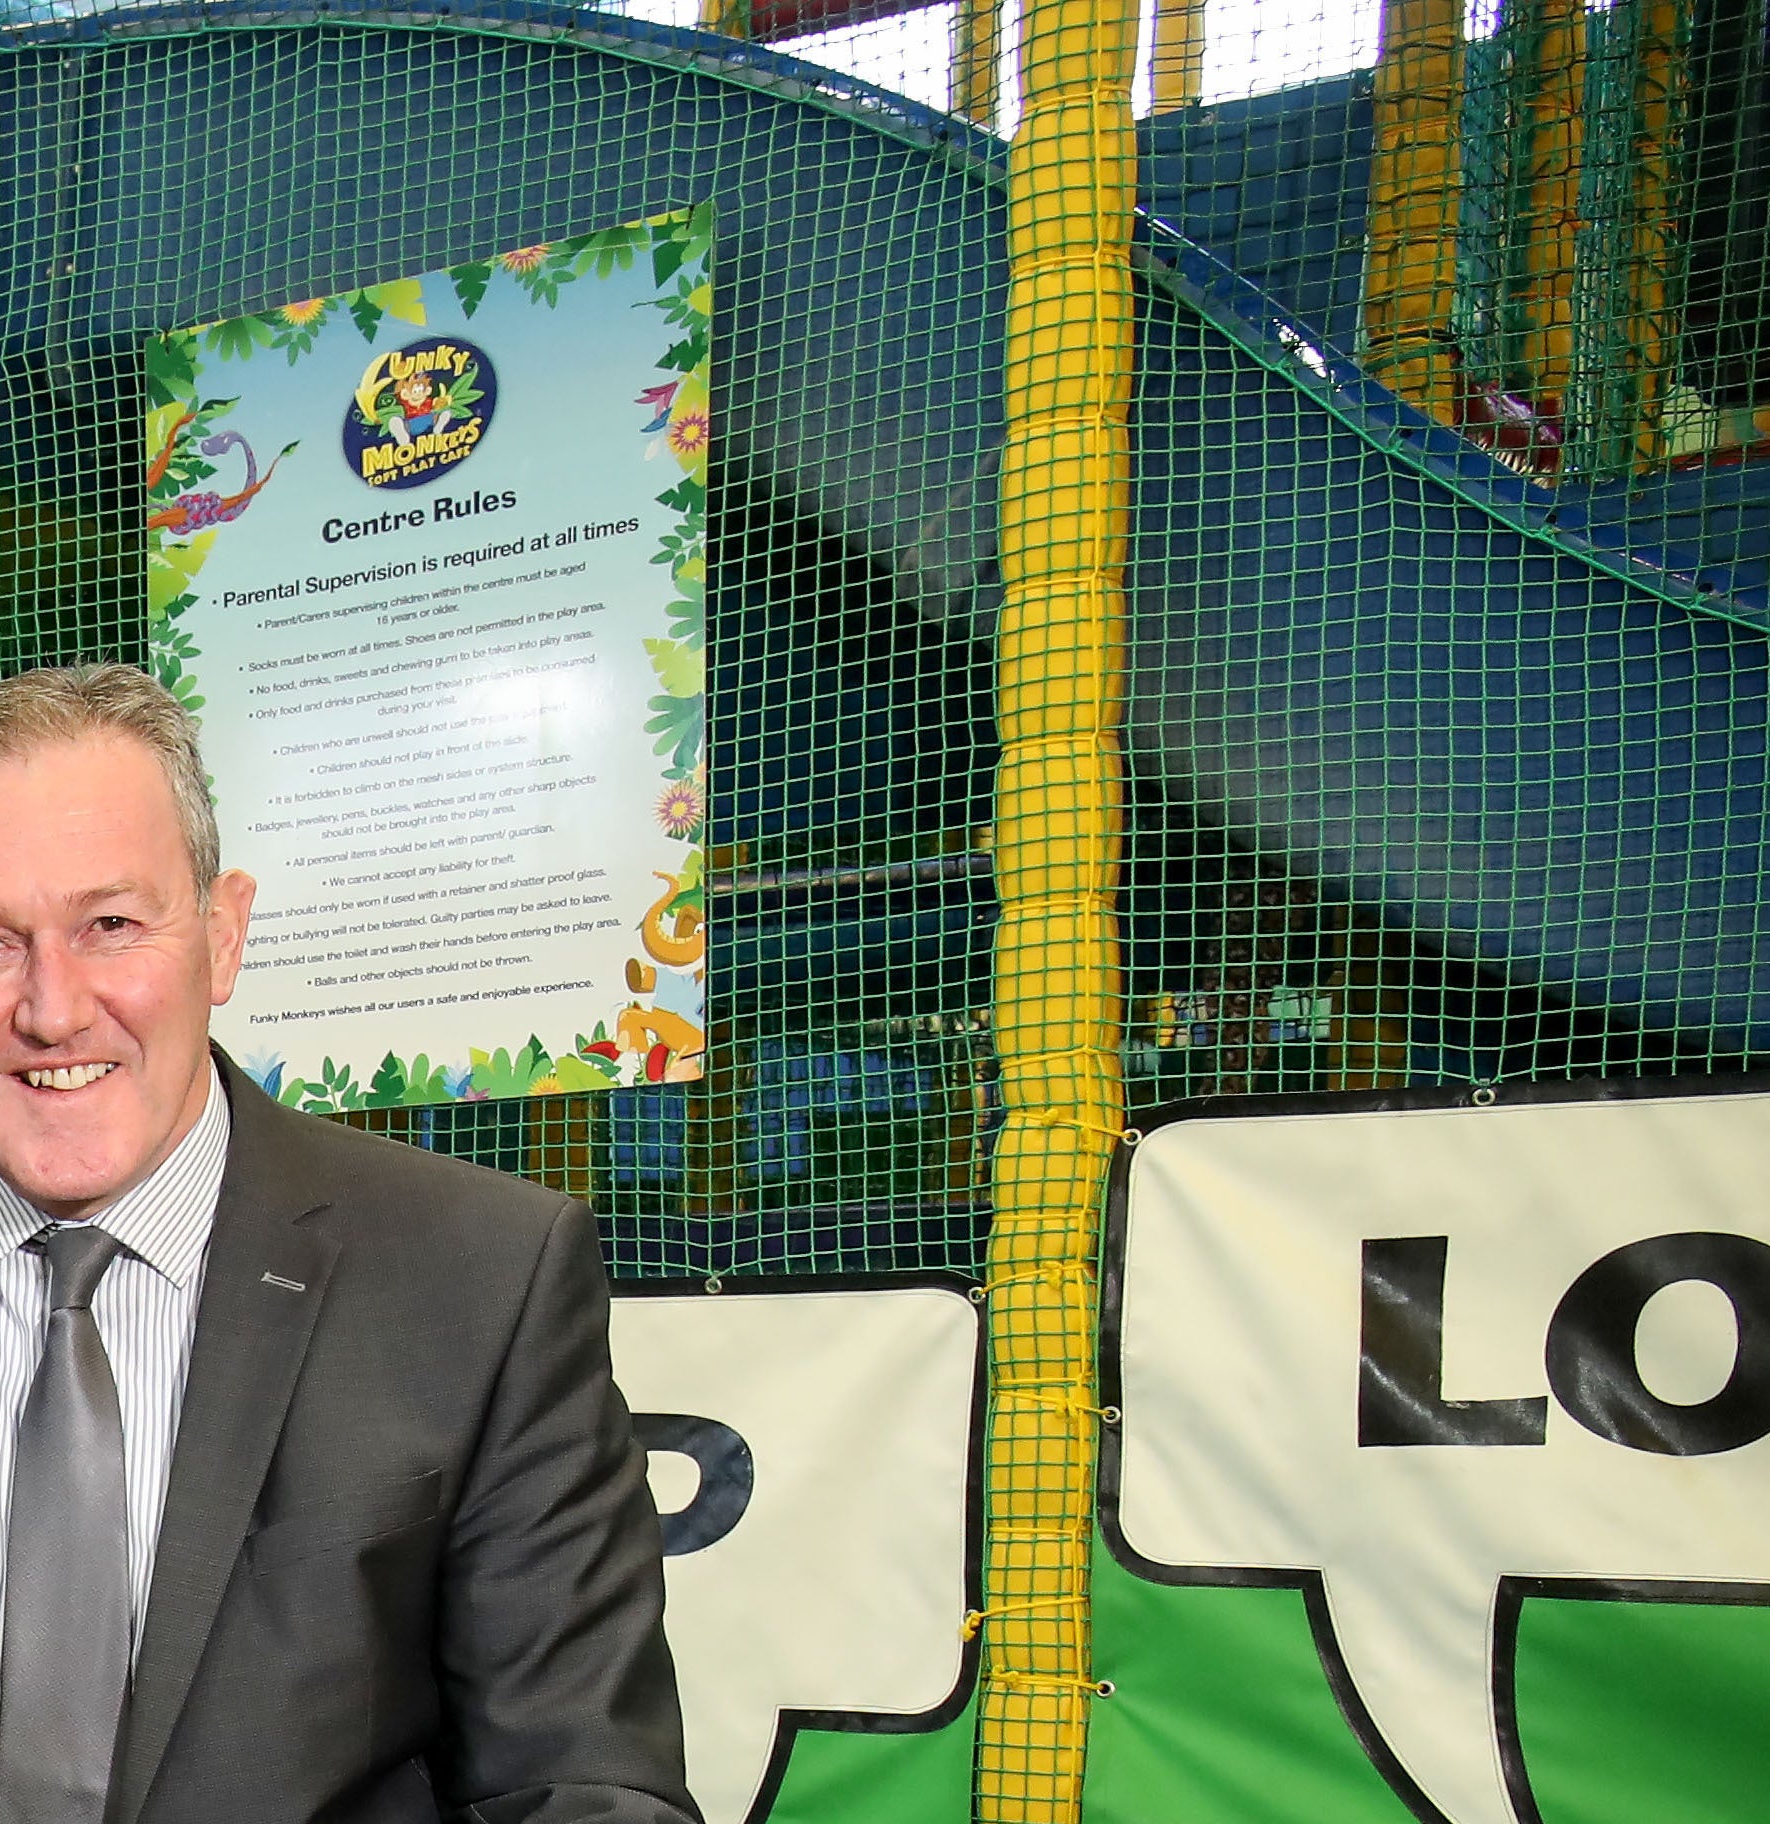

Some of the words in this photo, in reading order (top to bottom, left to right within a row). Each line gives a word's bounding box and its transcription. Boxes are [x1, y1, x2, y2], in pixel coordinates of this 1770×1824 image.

[362, 417, 482, 478] MONKEYS
[368, 469, 399, 488] SOFT
[403, 456, 436, 477] PLAY
[321, 509, 426, 544] Centre
[433, 490, 517, 523] Rules
[223, 579, 300, 609] Parental
[305, 561, 417, 594] Supervision
[422, 555, 439, 573] is
[443, 536, 525, 569] required
[530, 532, 551, 552] at
[555, 525, 577, 547] all
[582, 517, 640, 541] times
[264, 610, 331, 630] Parent/Carers
[332, 600, 389, 618] supervising
[389, 592, 430, 608] children
[431, 586, 462, 600] within
[463, 583, 480, 594] the
[481, 577, 515, 591] centre
[515, 569, 543, 584] must
[543, 568, 558, 579] be
[559, 560, 587, 577] aged
[248, 659, 279, 673] Socks
[279, 654, 305, 667] must
[306, 652, 320, 663] be
[320, 648, 347, 660] worn
[347, 645, 359, 656] at
[359, 642, 372, 654] all
[372, 639, 404, 652] times.
[404, 633, 437, 646] Shoes
[437, 629, 456, 641] are
[456, 624, 474, 637] not
[475, 614, 525, 636] permitted
[525, 614, 537, 624] in
[537, 611, 555, 622] the
[556, 606, 579, 621] play
[579, 601, 606, 614] area.
[292, 856, 306, 868] All
[306, 850, 349, 868] personal
[349, 849, 378, 860] items
[378, 841, 413, 857] should
[414, 841, 428, 852] be
[428, 838, 446, 849] left
[446, 834, 469, 847] with
[469, 828, 507, 846] parent/
[507, 824, 556, 841] guardian.
[328, 876, 346, 888] We
[346, 871, 382, 886] cannot
[382, 867, 417, 881] accept
[418, 865, 438, 877] any
[438, 860, 474, 873] liability
[474, 858, 490, 868] for
[490, 853, 516, 866] theft.
[279, 933, 291, 943] or
[292, 929, 330, 941] bullying
[330, 924, 348, 936] will
[348, 923, 366, 934] not
[366, 921, 381, 932] be
[381, 915, 428, 930] tolerated.
[429, 912, 460, 925] Guilty
[460, 908, 496, 923] parties
[496, 905, 520, 916] may
[520, 902, 535, 913] be
[536, 896, 568, 911] asked
[569, 896, 581, 907] to
[582, 893, 613, 905] leave.
[284, 904, 318, 918] should
[318, 901, 340, 914] only
[341, 900, 355, 911] be
[356, 898, 382, 909] worn
[382, 895, 390, 905] if
[390, 891, 416, 904] used
[416, 888, 439, 901] with
[448, 884, 488, 897] retainer
[488, 879, 509, 892] and
[509, 876, 546, 889] shatter
[547, 870, 576, 886] proof
[576, 868, 607, 883] glass.
[272, 954, 306, 968] should
[306, 954, 326, 964] use
[326, 951, 343, 961] the
[344, 947, 369, 960] toilet
[369, 944, 390, 957] and
[390, 941, 418, 954] wash
[418, 938, 442, 951] their
[442, 935, 475, 948] hands
[475, 932, 509, 944] before
[509, 926, 552, 940] entering
[553, 923, 571, 934] the
[571, 920, 595, 934] play
[596, 918, 622, 929] area.
[314, 975, 338, 988] Balls
[339, 973, 359, 985] and
[359, 971, 386, 983] other
[387, 966, 424, 980] objects
[425, 961, 459, 975] should
[460, 959, 478, 971] not
[479, 958, 494, 969] be
[494, 954, 533, 967] thrown.
[249, 1013, 280, 1025] Funky
[281, 1009, 326, 1021] Monkeys
[327, 1005, 363, 1016] wishes
[363, 1001, 376, 1013] all
[377, 1001, 396, 1011] our
[396, 998, 426, 1009] users
[436, 993, 458, 1005] safe
[459, 990, 480, 1002] and
[481, 985, 532, 1001] enjoyable
[533, 979, 594, 995] experience.
